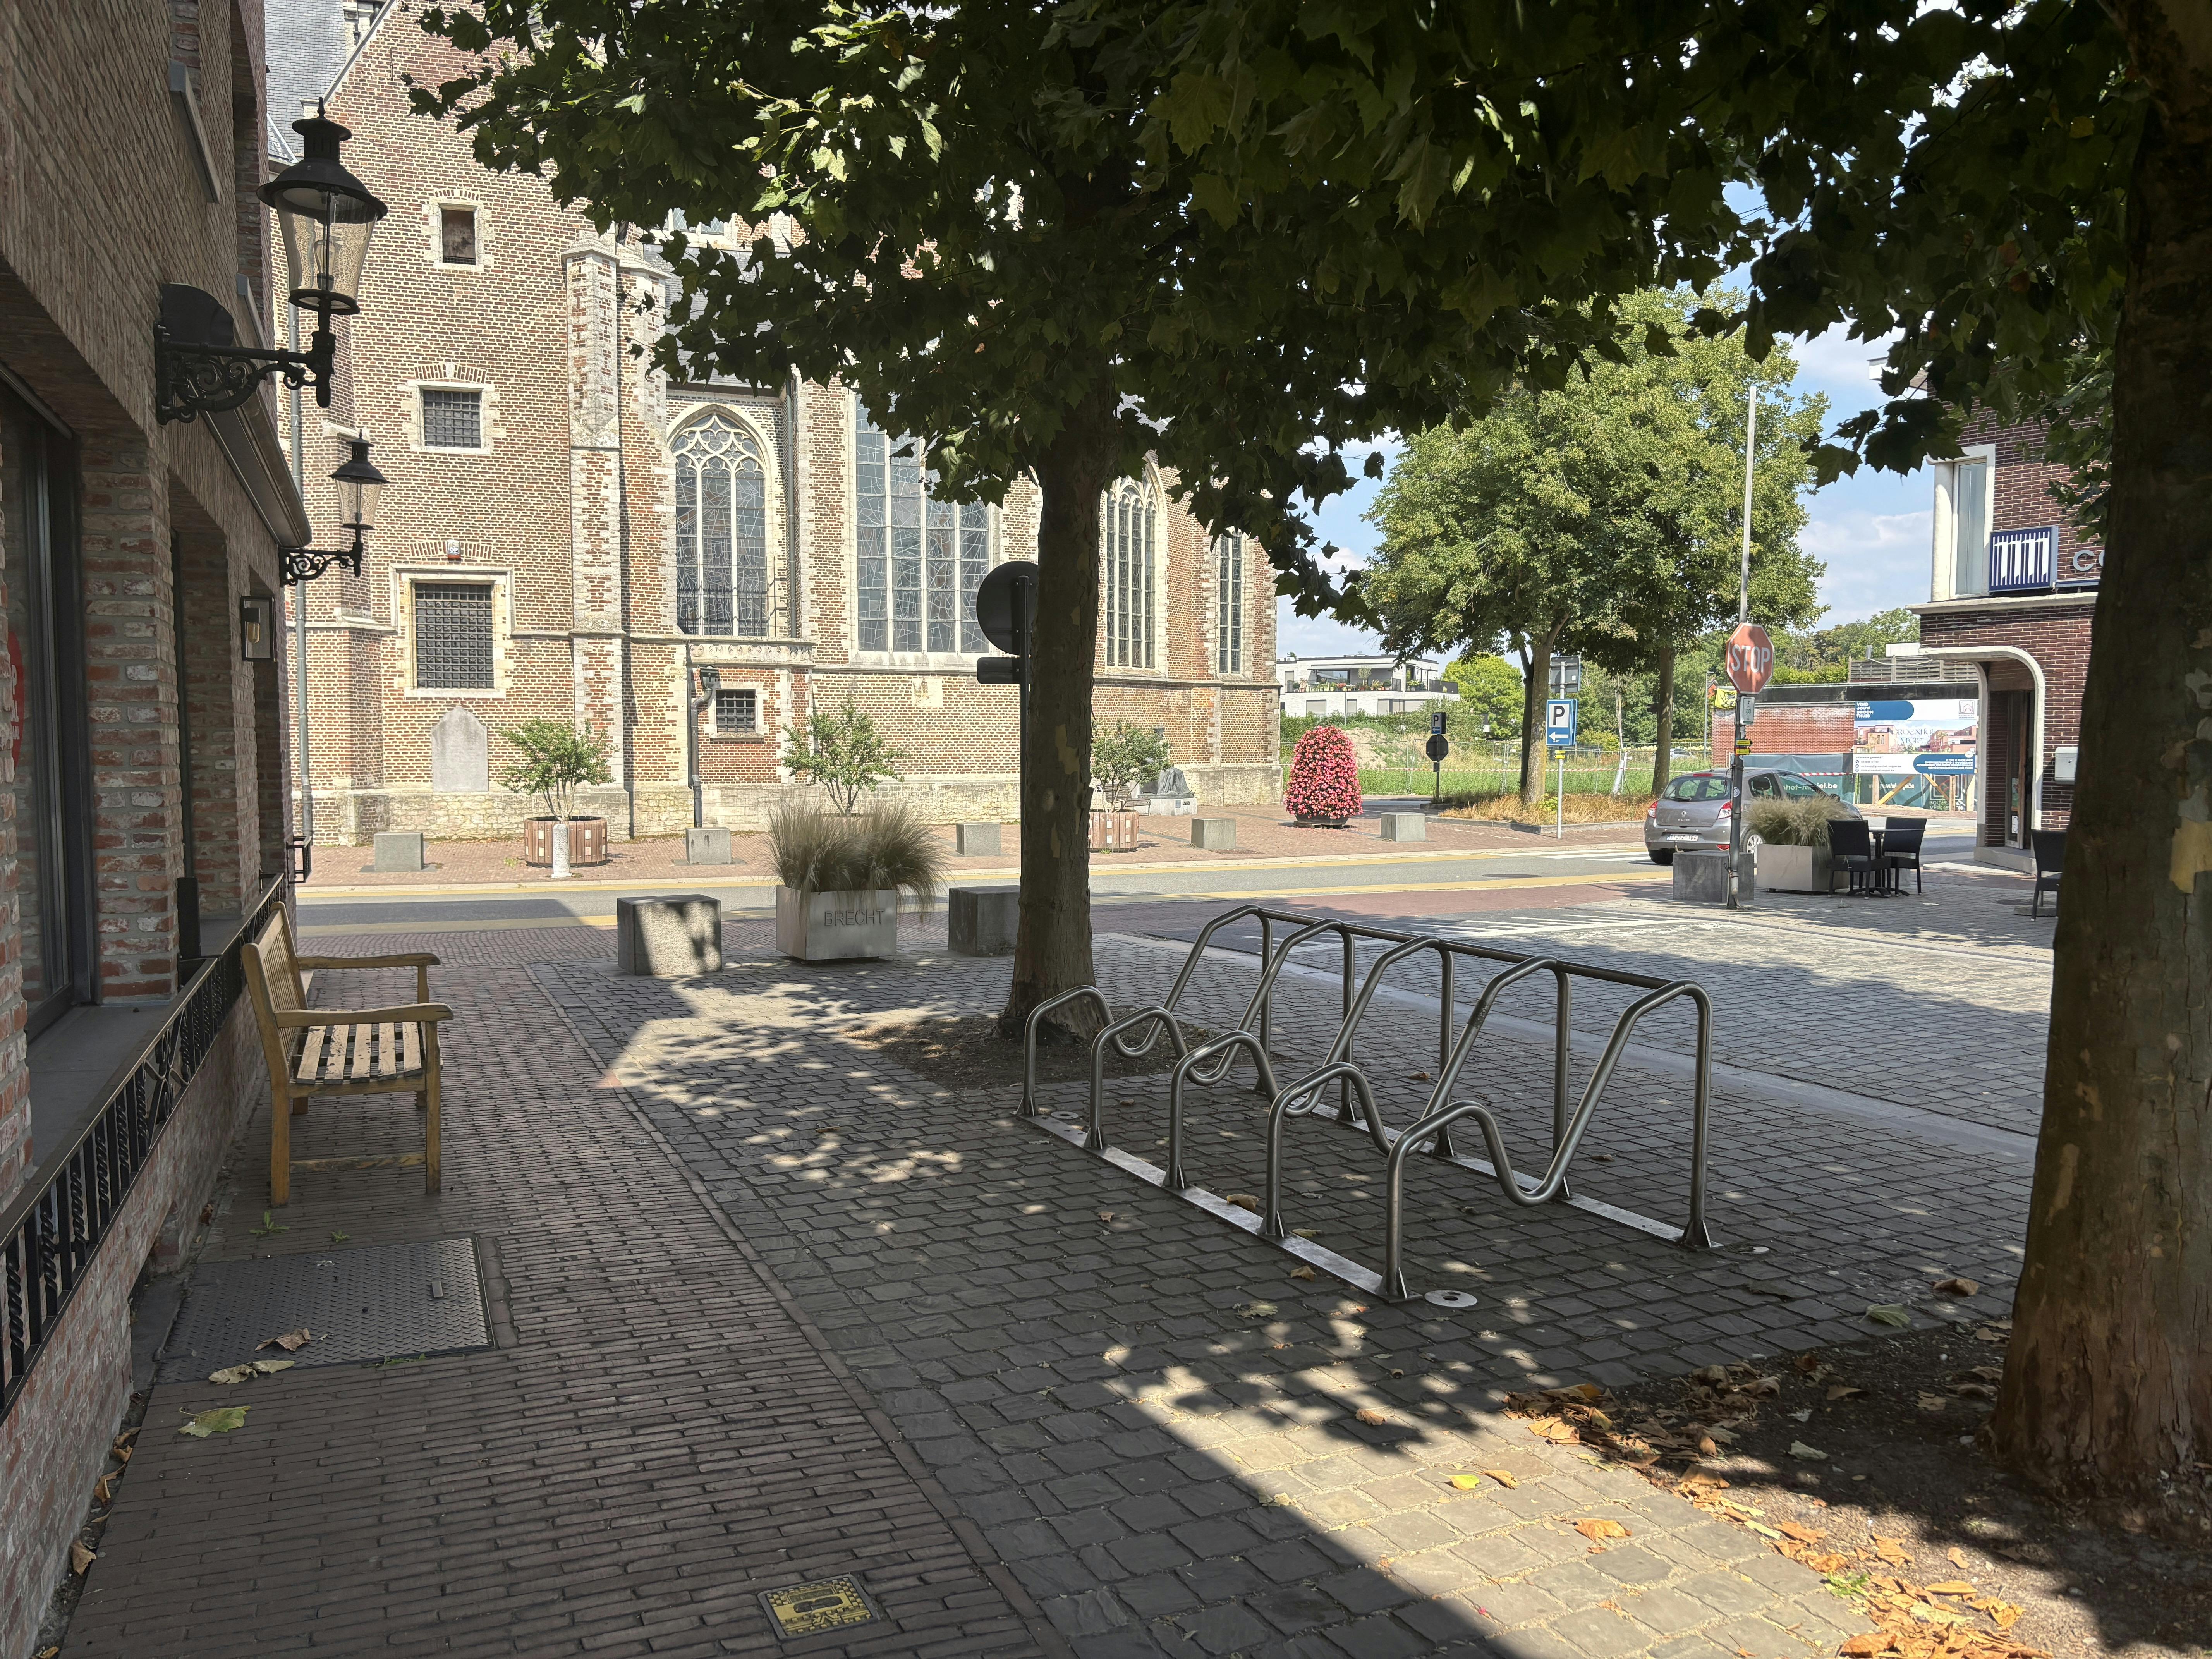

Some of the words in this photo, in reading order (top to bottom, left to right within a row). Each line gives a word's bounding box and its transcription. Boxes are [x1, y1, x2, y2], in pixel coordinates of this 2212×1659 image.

[1731, 644, 1770, 673] STOP
[1433, 715, 1439, 726] P
[1553, 706, 1565, 725] P
[824, 909, 886, 926] BRECHT
